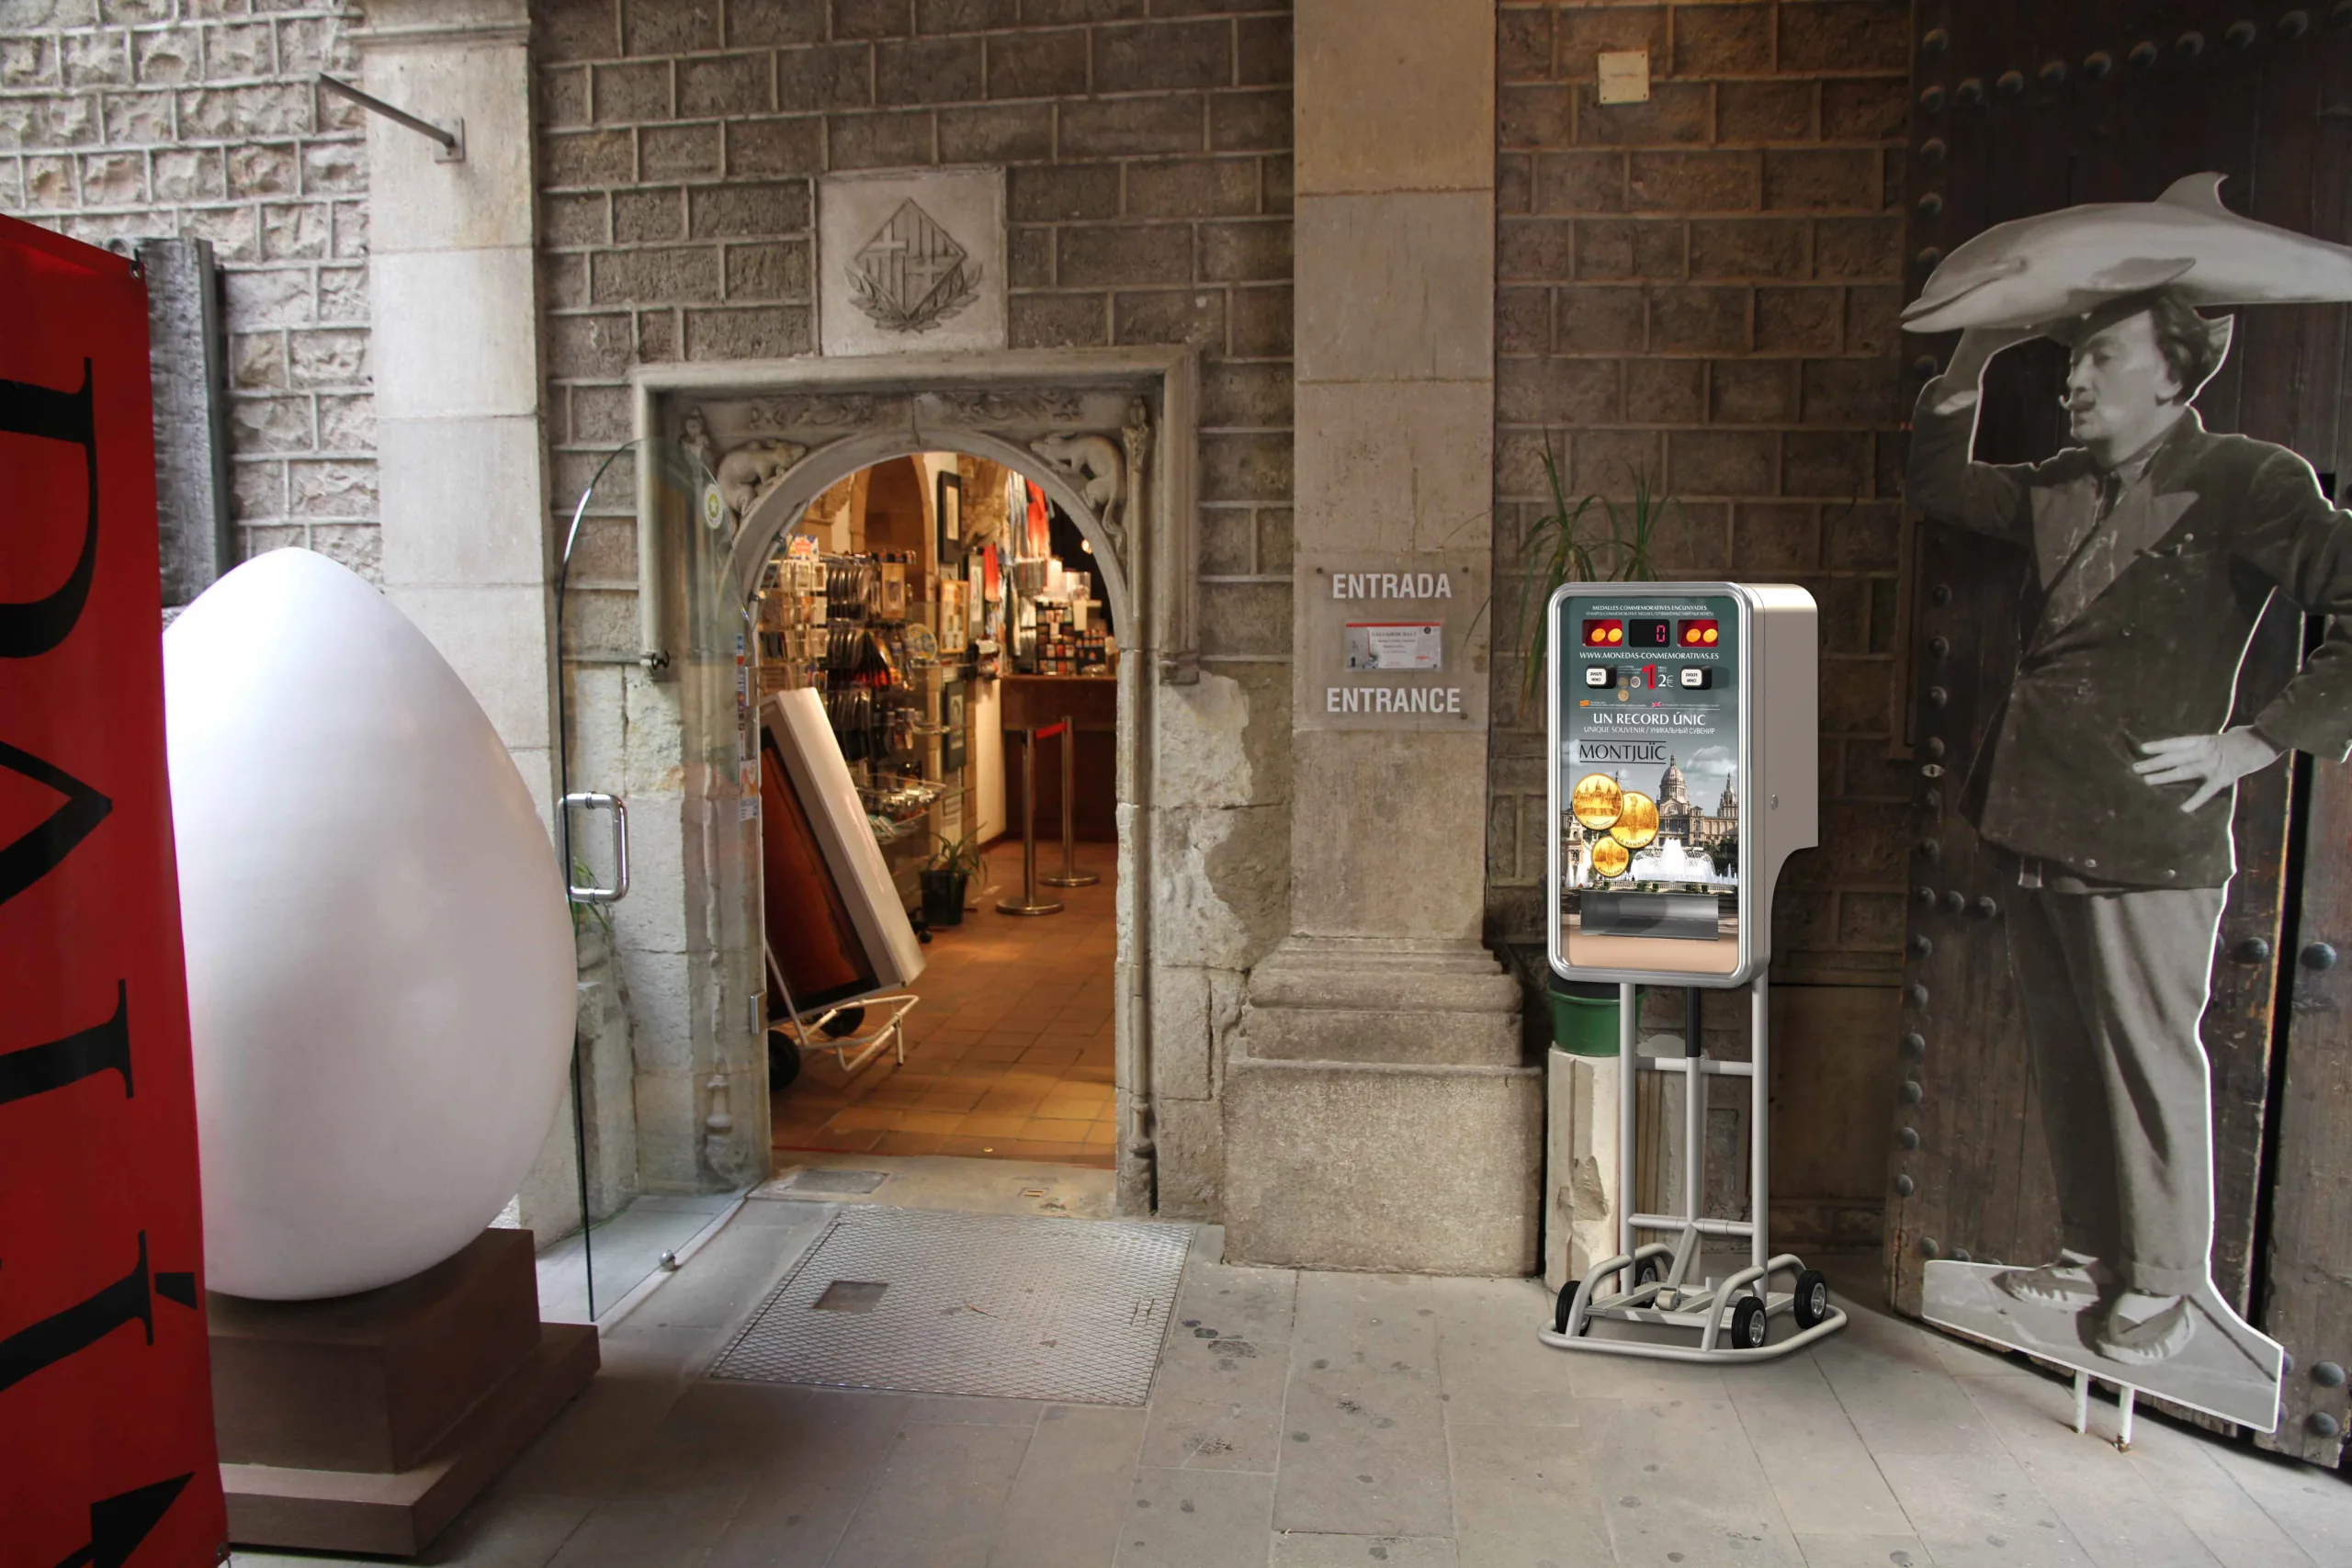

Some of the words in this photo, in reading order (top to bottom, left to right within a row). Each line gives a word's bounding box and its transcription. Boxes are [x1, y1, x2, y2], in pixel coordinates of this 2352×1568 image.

[1333, 573, 1452, 598] ENTRADA
[1656, 625, 1665, 642] 0
[1579, 651, 1719, 660] WWW.MONEDAS-CONMEMORATIVAS.ES
[1657, 673, 1674, 687] 2€
[1327, 687, 1461, 713] ENTRANCE
[1593, 714, 1612, 724] UN
[1617, 714, 1669, 725] RECORD
[1673, 711, 1706, 726] ÚNIC
[1579, 742, 1667, 761] MONTJUÏC
